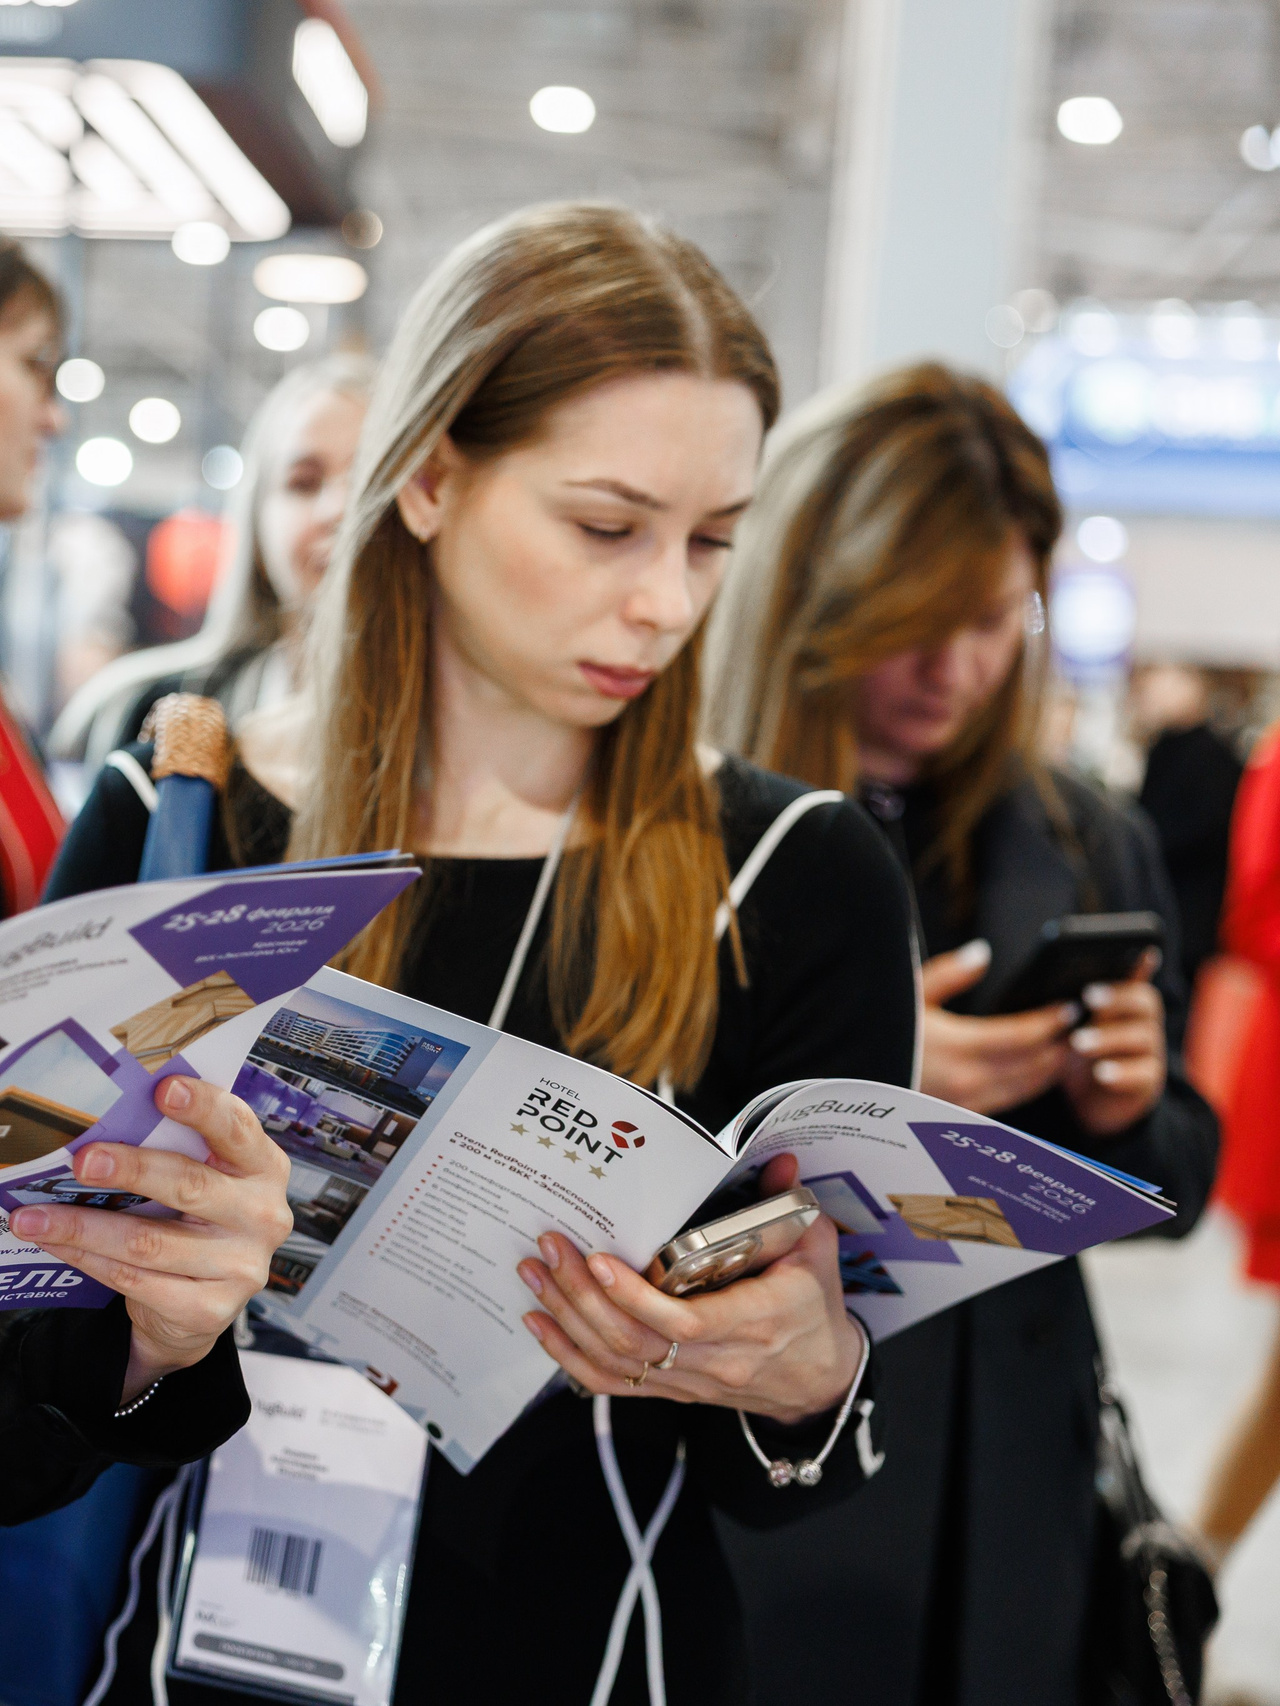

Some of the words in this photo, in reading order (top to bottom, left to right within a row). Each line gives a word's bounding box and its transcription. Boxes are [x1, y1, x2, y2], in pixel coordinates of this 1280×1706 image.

[162, 904, 248, 932] 25-28
[261, 914, 331, 934] 2026
[527, 1087, 598, 1128] RED
[539, 1077, 581, 1101] HOTEL
[516, 1102, 623, 1164] POINT
[454, 1131, 488, 1151] Отель
[490, 1147, 538, 1176] RedPoint
[552, 1181, 615, 1228] расположен
[459, 1140, 482, 1156] 200
[494, 1159, 506, 1169] от
[508, 1165, 531, 1181] ВКК
[940, 1130, 1017, 1164] 25-28
[1016, 1163, 1097, 1206] февраля
[1028, 1182, 1093, 1215] 2026
